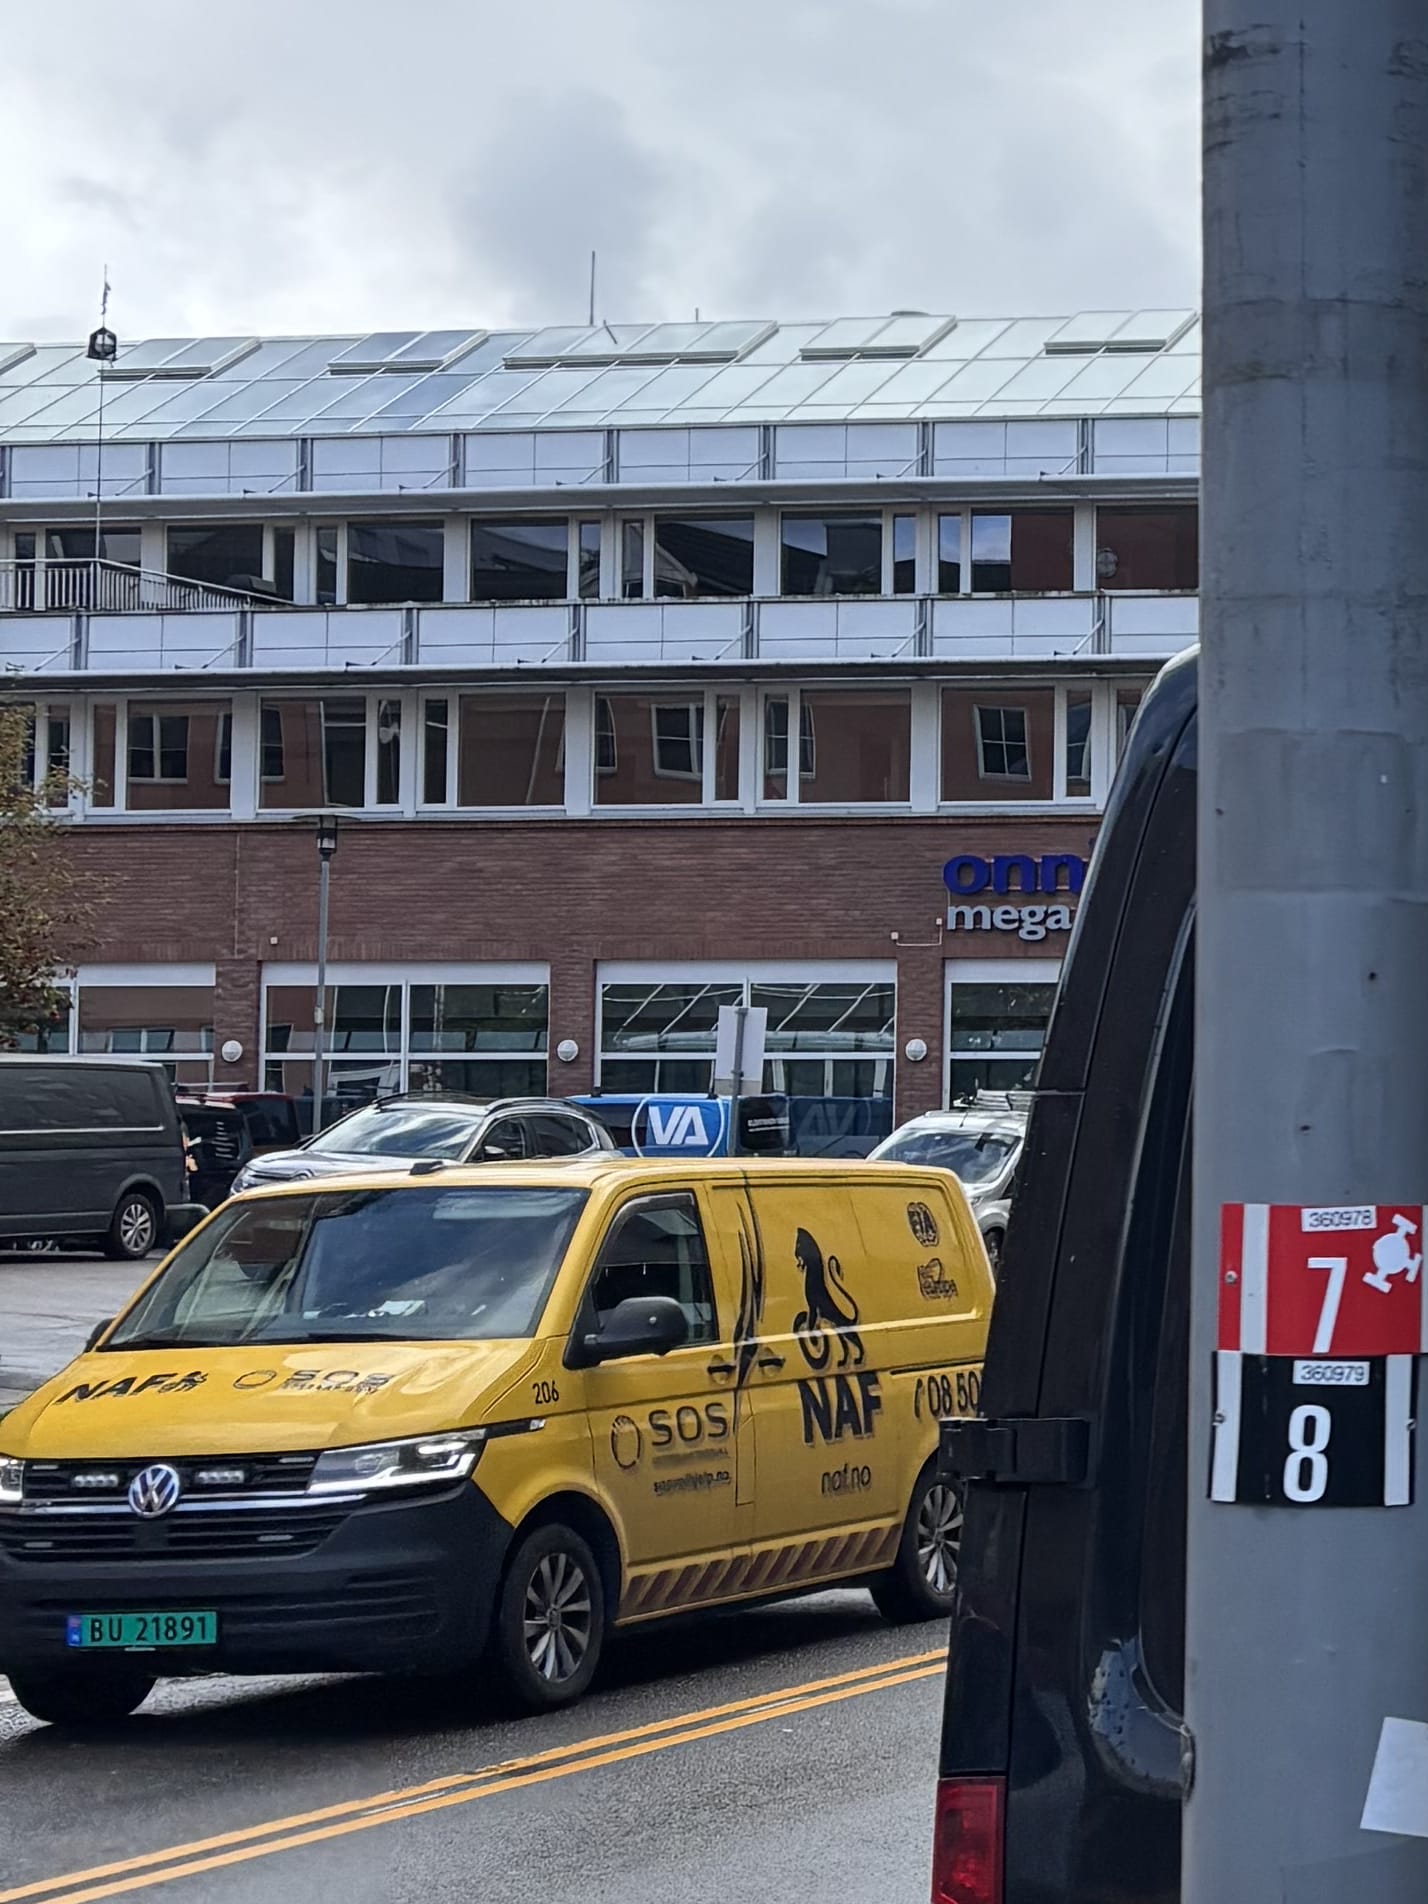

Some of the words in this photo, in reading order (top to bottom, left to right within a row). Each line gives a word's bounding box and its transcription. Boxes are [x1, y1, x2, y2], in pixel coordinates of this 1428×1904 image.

[943, 839, 1093, 894] onn
[649, 1106, 708, 1145] VA
[1309, 1208, 1372, 1228] 360978
[1307, 1257, 1348, 1353] 7
[532, 1380, 560, 1405] 206
[1301, 1365, 1364, 1382] 360979
[798, 1371, 884, 1446] NAF
[927, 1375, 951, 1418] 08
[649, 1402, 728, 1446] SOS
[1283, 1404, 1332, 1502] 8
[91, 1617, 122, 1643] BU
[135, 1616, 206, 1641] 21891
